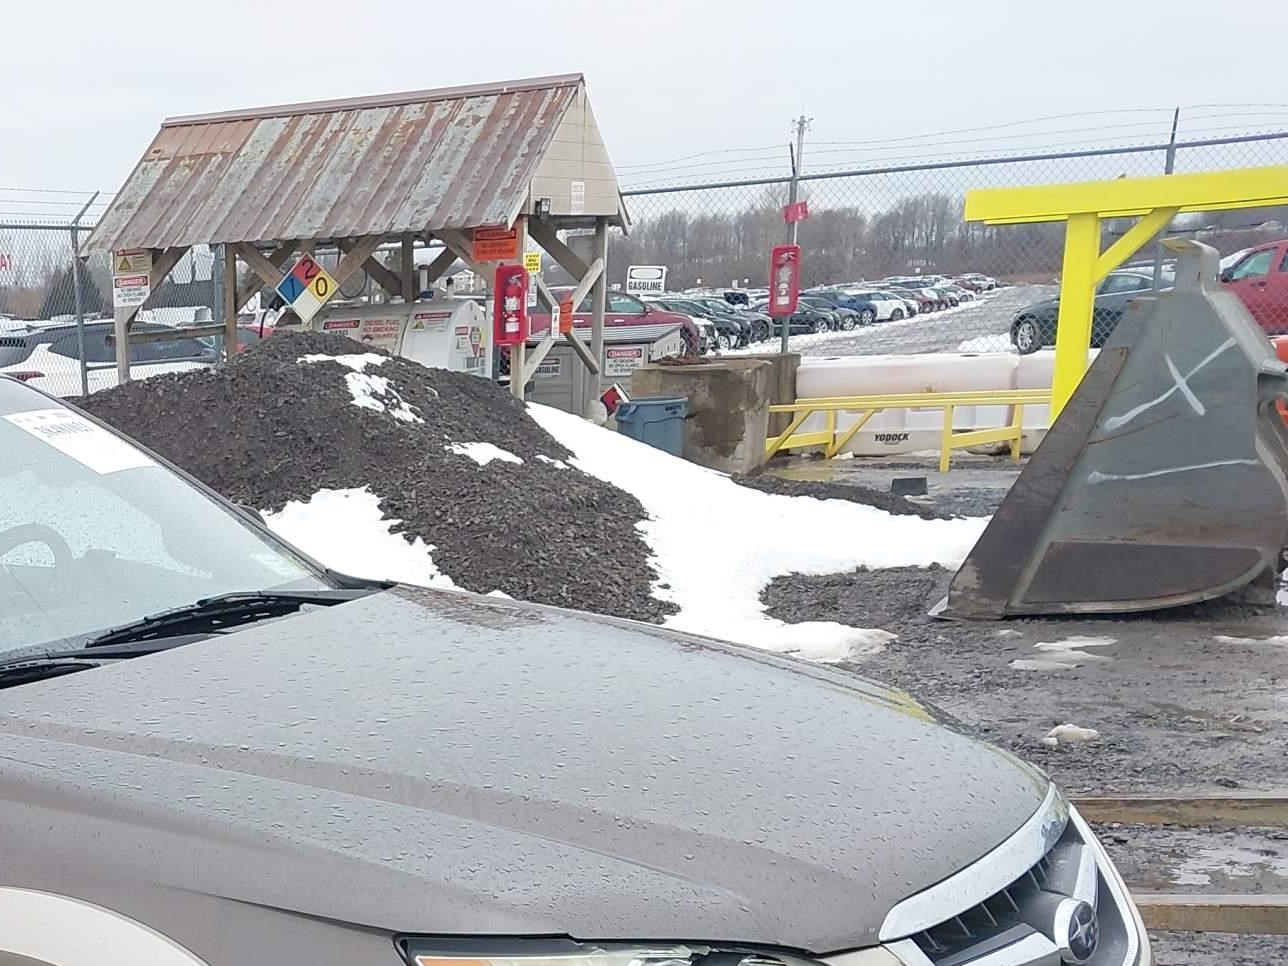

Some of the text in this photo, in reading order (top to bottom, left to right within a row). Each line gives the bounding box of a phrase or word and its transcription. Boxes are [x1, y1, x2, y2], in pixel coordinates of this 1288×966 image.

[301, 260, 317, 280] 2
[289, 278, 296, 297] 1
[315, 277, 328, 297] 0
[628, 281, 662, 291] GASOLINE
[874, 432, 910, 442] YODOCK
